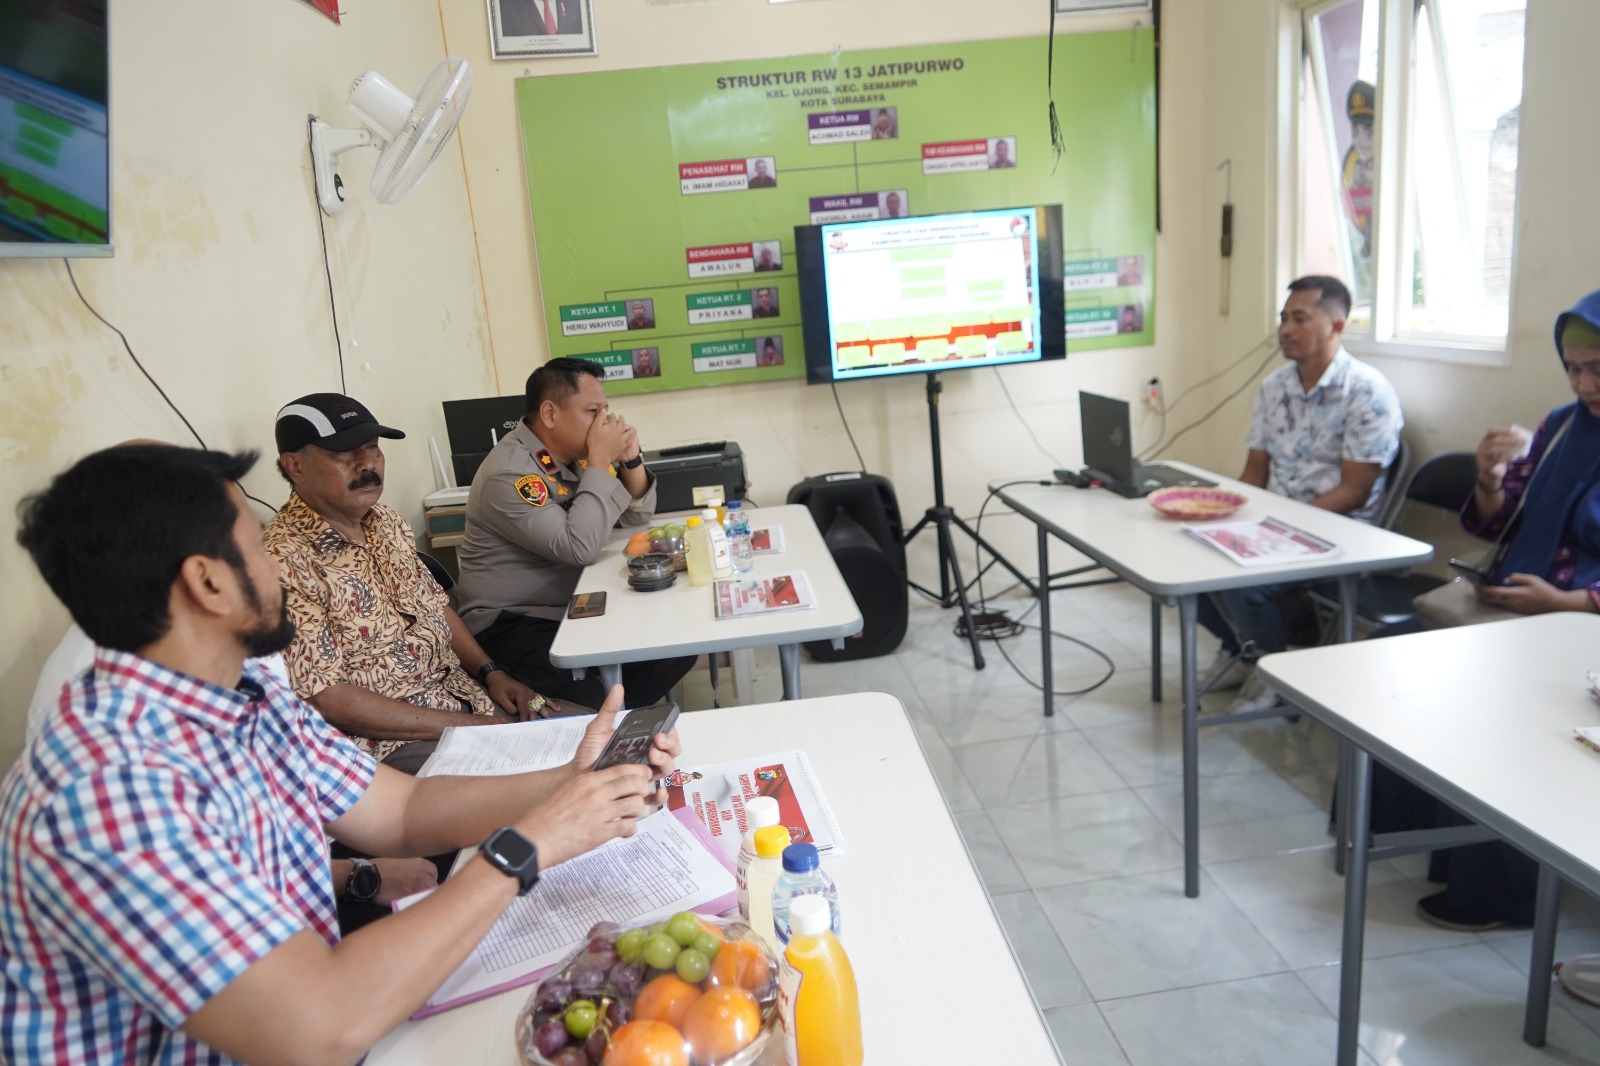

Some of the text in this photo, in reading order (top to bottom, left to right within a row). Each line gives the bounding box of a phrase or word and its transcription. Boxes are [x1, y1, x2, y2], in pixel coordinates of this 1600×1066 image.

[716, 57, 964, 90] STRUKTUR RW 13 JATIPURWO
[766, 79, 918, 99] KEL. UJUNG, KEC. SEMAMPIR
[800, 93, 886, 108] KOTA SURABAYA
[819, 115, 845, 125] KETUA
[682, 163, 744, 176] PENASEHAT RW
[692, 182, 713, 190] IMAM
[689, 245, 750, 259] BENDAHARA RW
[696, 293, 742, 305] KETUA RT. 2
[571, 305, 616, 316] KETUA RT. 1
[566, 319, 625, 331] HERU WAHYUDI
[702, 343, 746, 354] KETUA RT. 7
[604, 356, 616, 364] RT.
[709, 360, 724, 368] MAT
